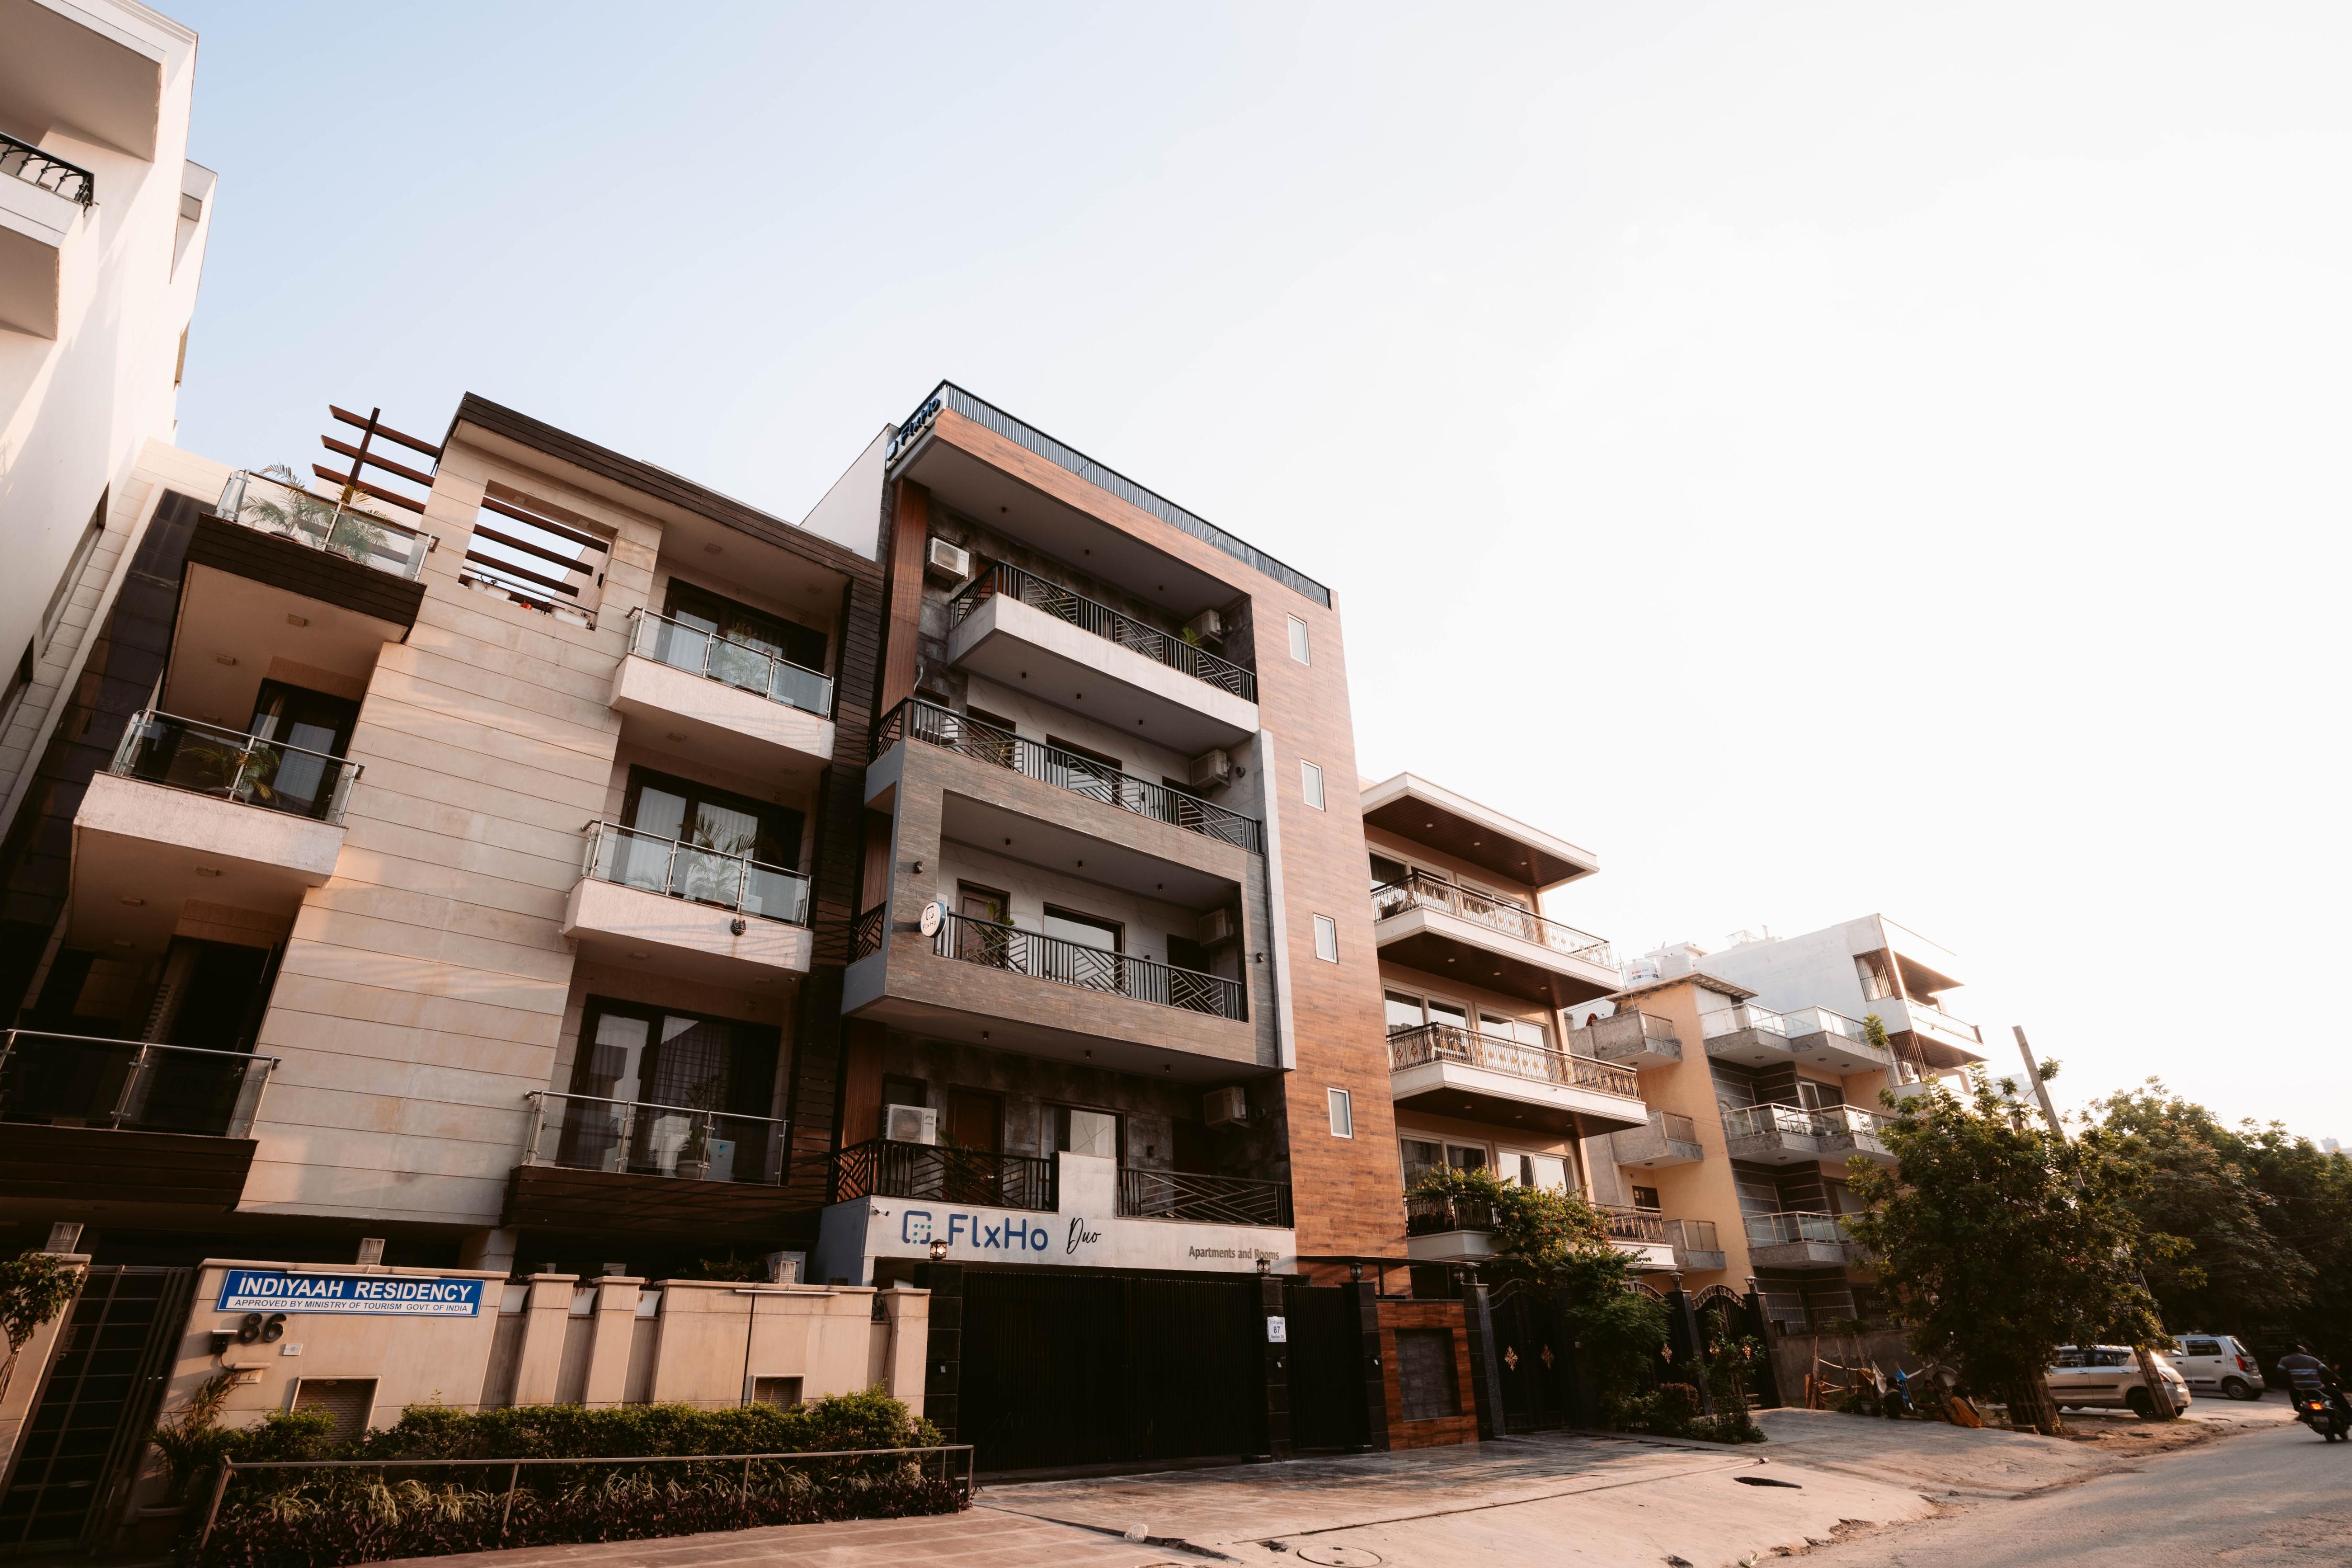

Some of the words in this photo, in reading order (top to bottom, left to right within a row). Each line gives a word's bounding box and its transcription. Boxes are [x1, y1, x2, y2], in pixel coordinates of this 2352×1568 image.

[948, 1213, 1048, 1251] FlxHo
[1066, 1217, 1102, 1254] Duo
[1189, 1246, 1236, 1260] Apartments
[1238, 1248, 1252, 1259] and
[1254, 1248, 1280, 1261] Rooms
[237, 1276, 344, 1298] INDIYAAH
[354, 1281, 472, 1301] RESIDENCY
[234, 1299, 287, 1308] APPROVED
[305, 1300, 348, 1309] MINISTRY
[364, 1302, 402, 1310] TOURISM
[239, 1312, 287, 1343] 86
